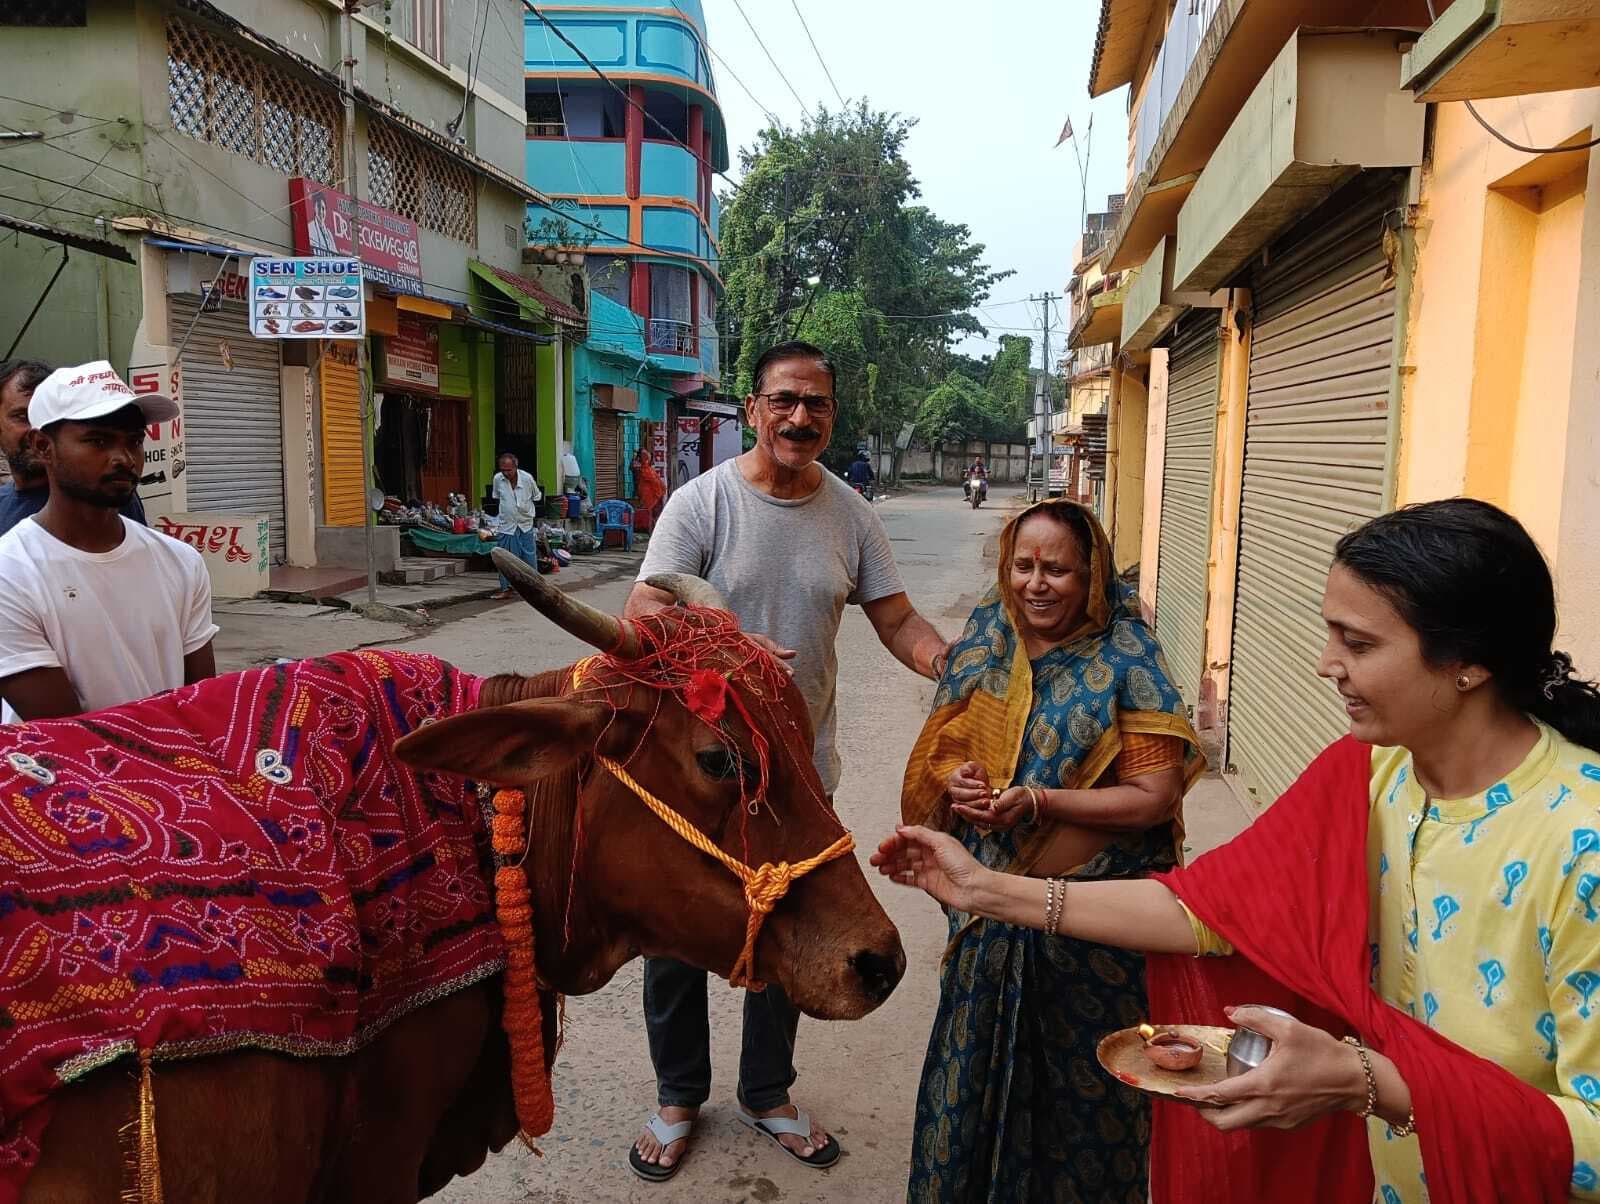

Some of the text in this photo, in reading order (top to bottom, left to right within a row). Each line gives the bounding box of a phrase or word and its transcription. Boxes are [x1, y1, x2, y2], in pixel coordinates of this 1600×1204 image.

[256, 261, 359, 275] SEN SHOE
[391, 271, 422, 295] CENTRE
[144, 448, 166, 462] HOE
